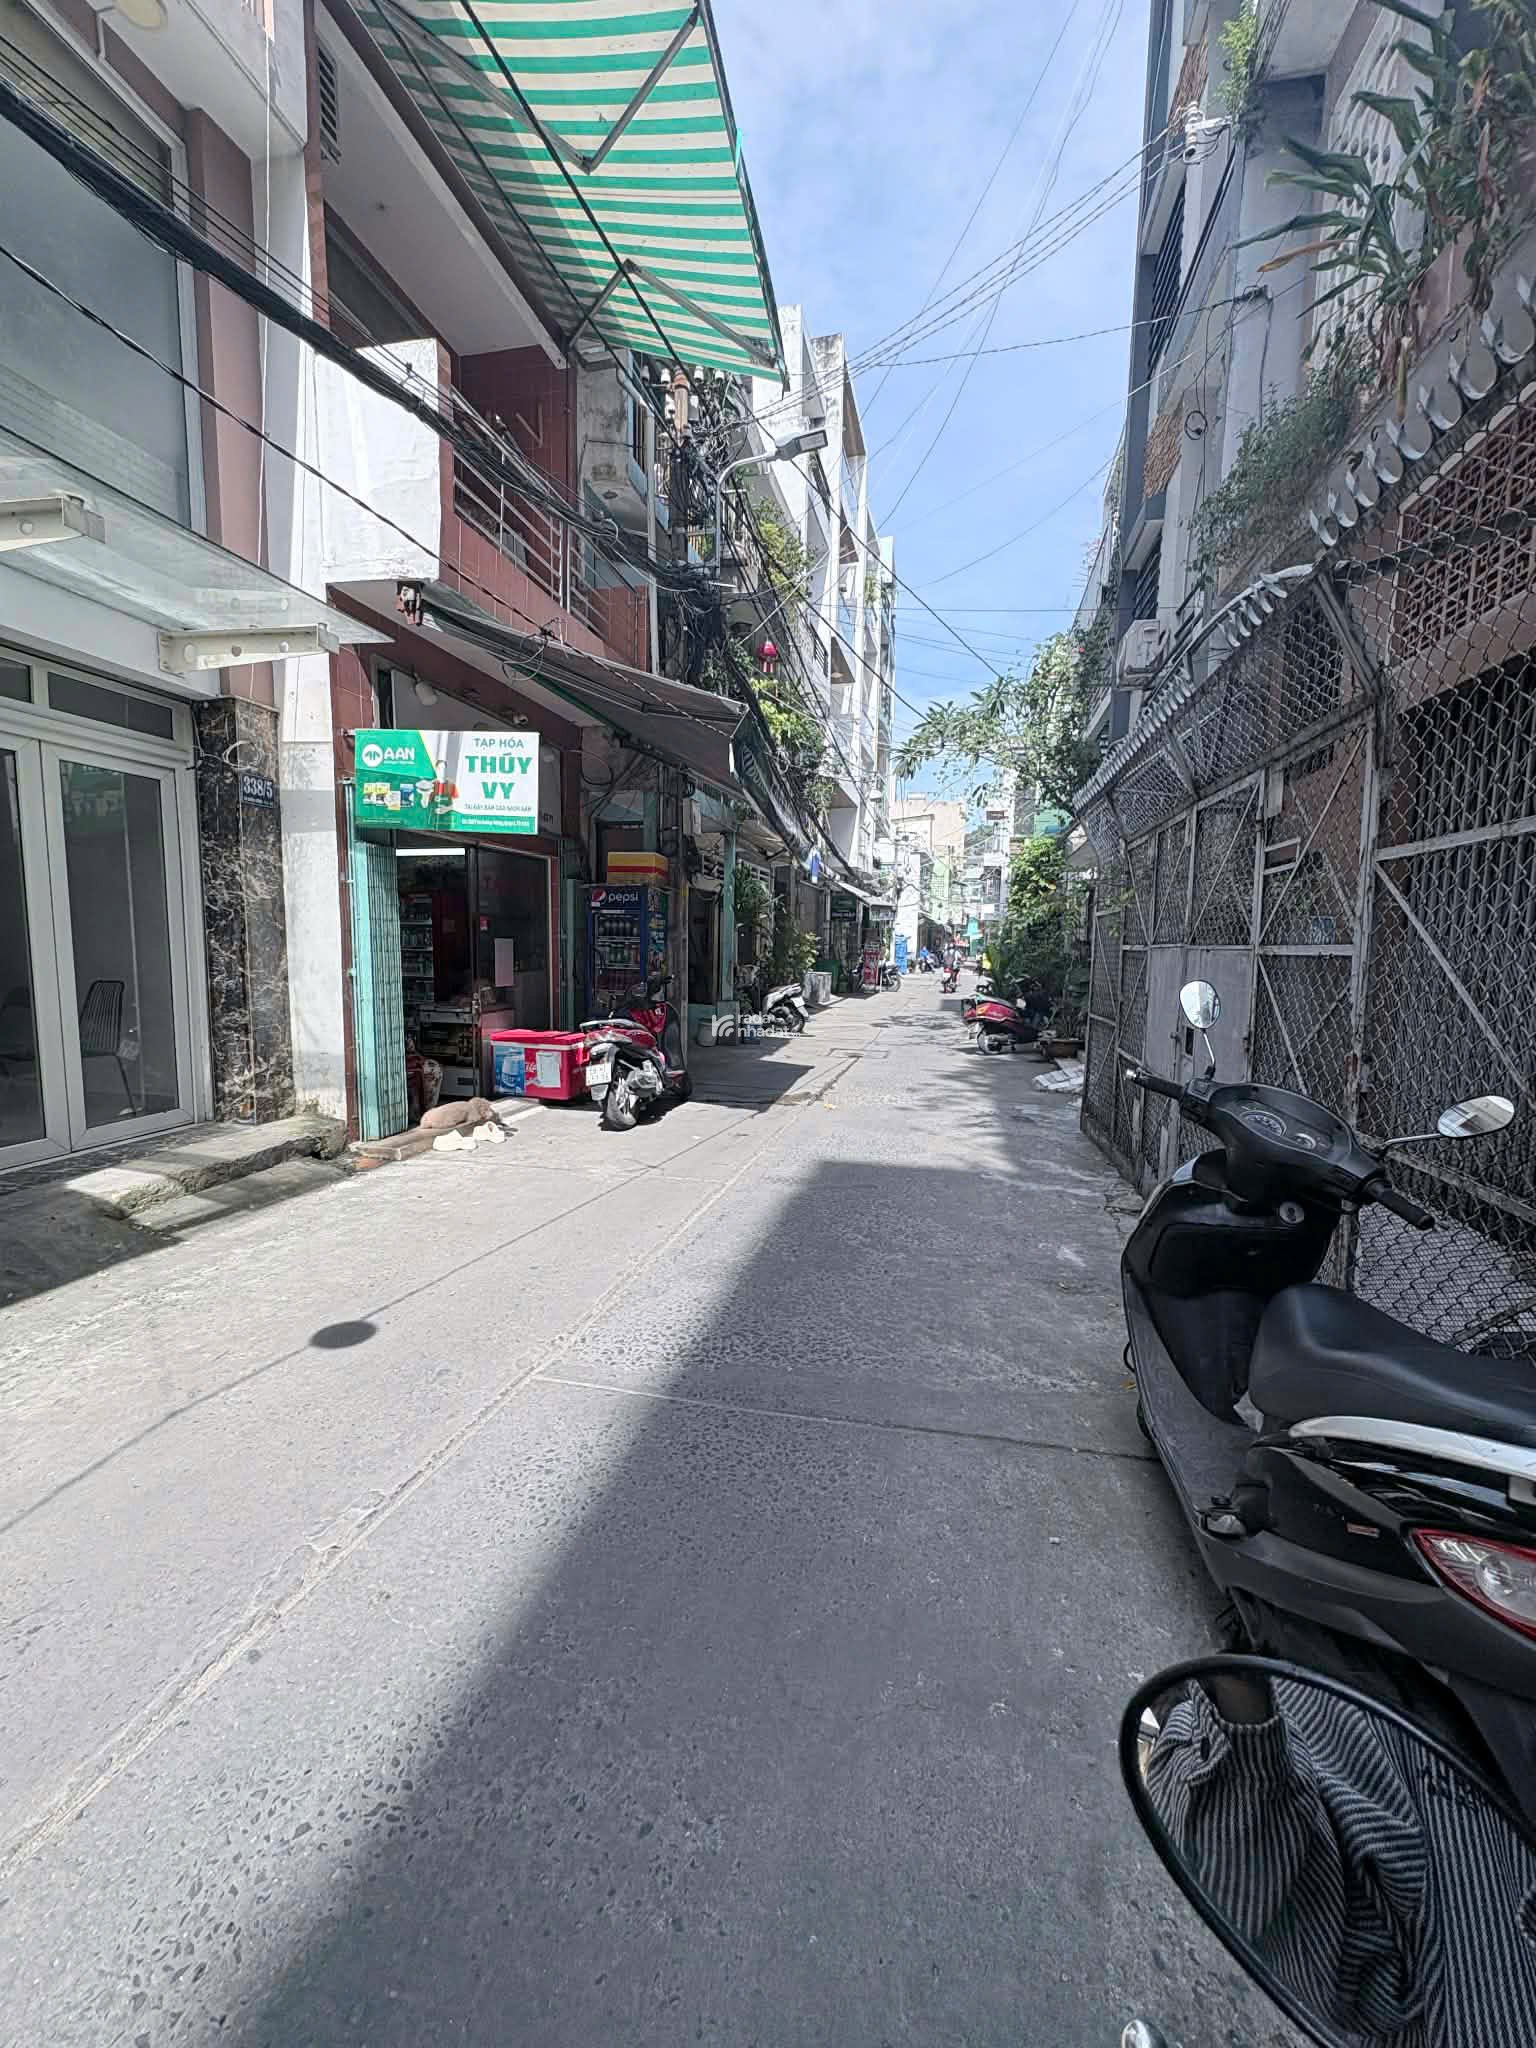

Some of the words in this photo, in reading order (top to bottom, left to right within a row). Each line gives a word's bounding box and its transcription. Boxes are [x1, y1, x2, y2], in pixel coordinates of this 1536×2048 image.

[472, 738, 496, 750] TẠP
[499, 737, 524, 749] HÓA
[383, 747, 415, 761] AAN
[464, 752, 533, 775] THÚY
[243, 775, 273, 799] 338/5
[481, 781, 515, 800] VY
[608, 891, 639, 904] pepsi
